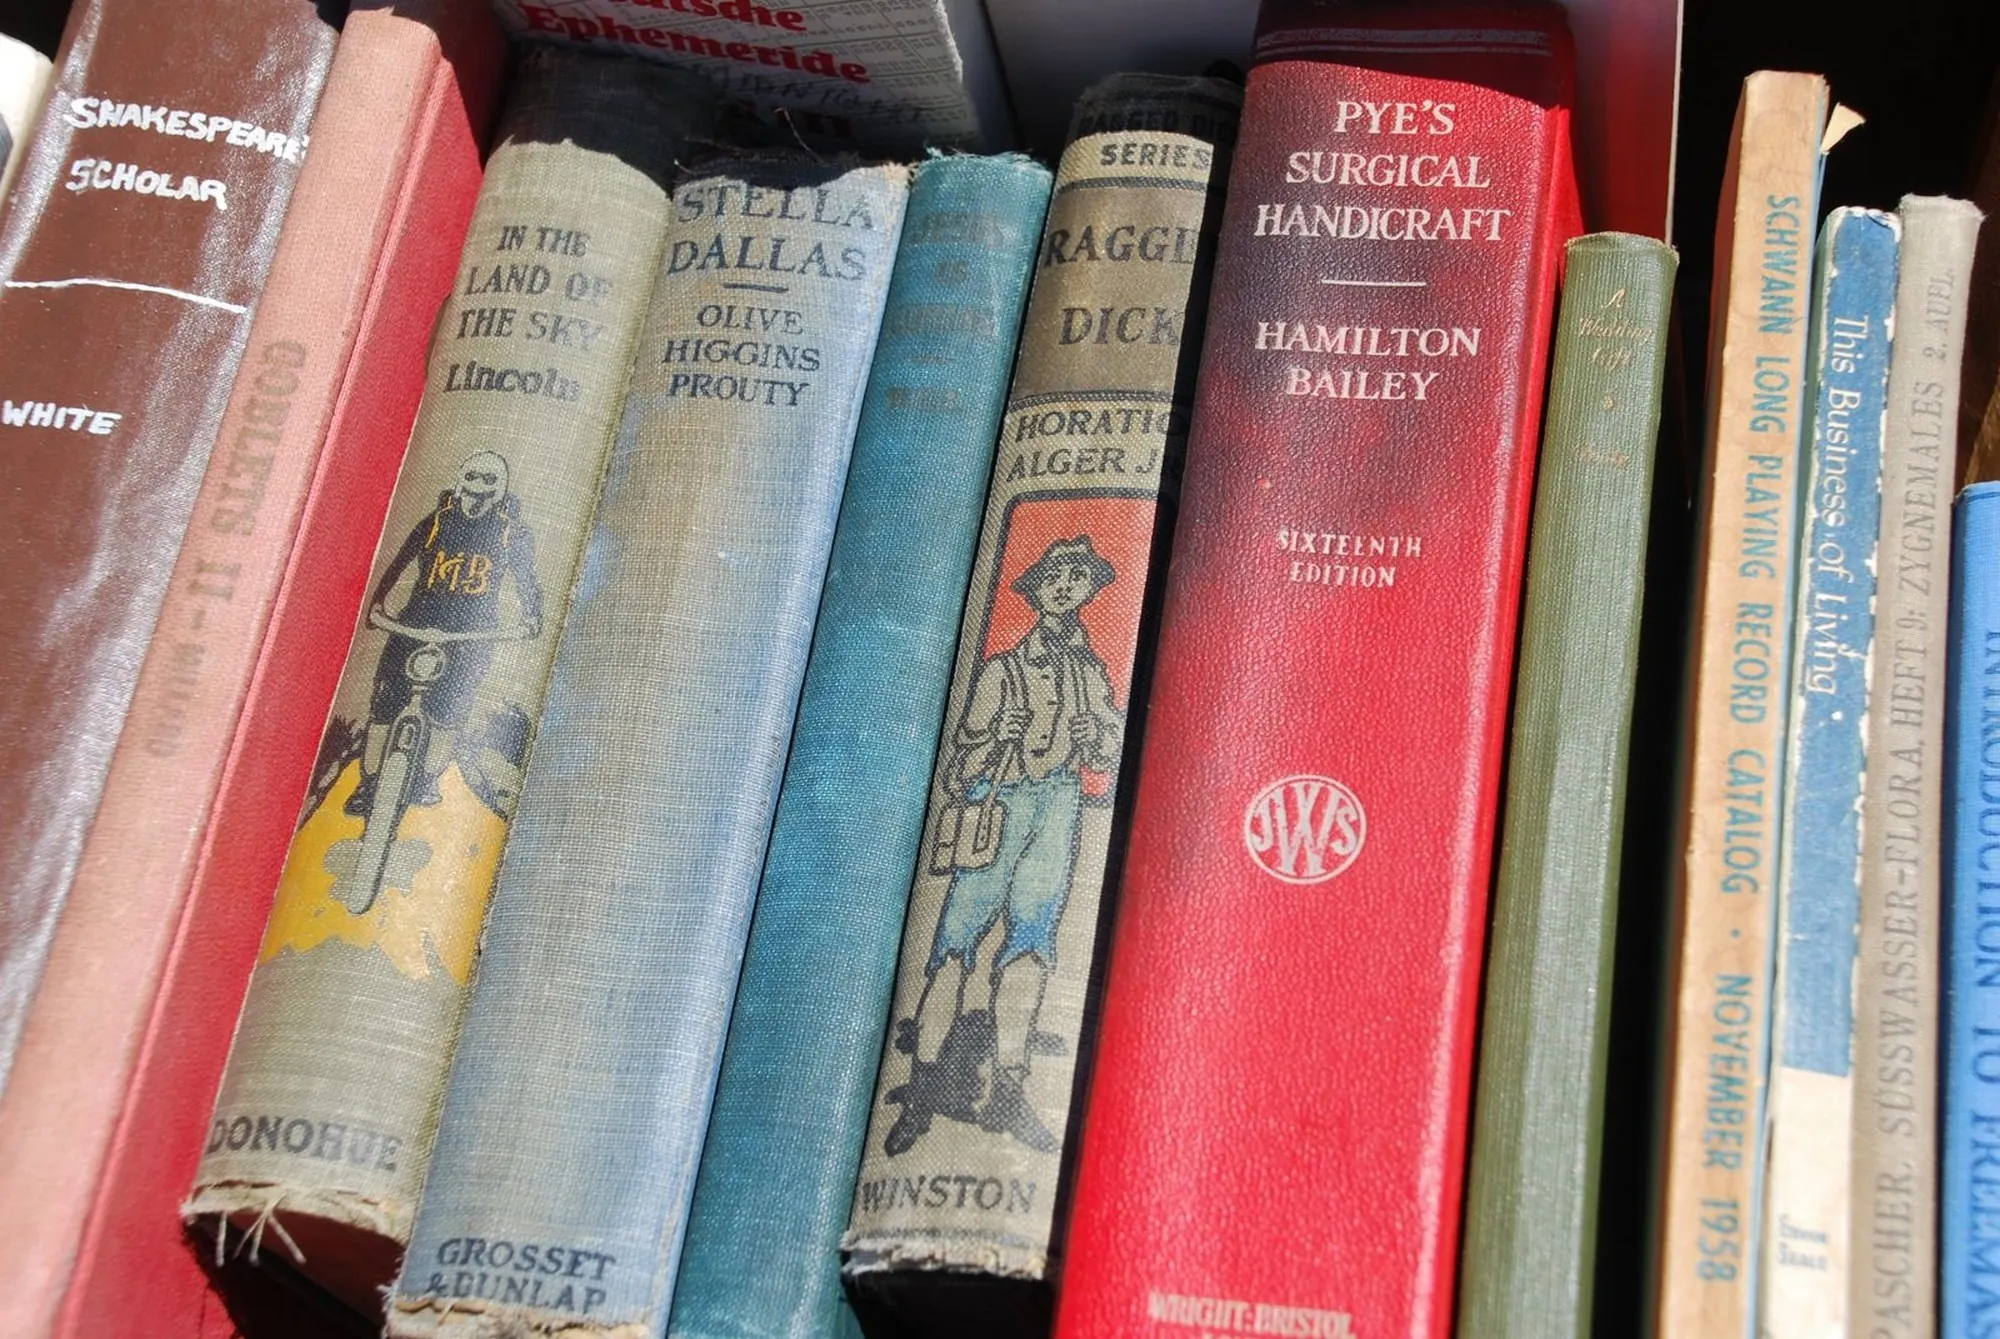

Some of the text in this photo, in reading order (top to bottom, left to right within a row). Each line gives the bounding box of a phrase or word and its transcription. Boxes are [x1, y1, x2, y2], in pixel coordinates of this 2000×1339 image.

[521, 3, 870, 84] Ephemeride
[63, 96, 310, 165] SHAKESPEARE
[1334, 98, 1456, 135] PYE'S
[1099, 142, 1213, 169] SERIES
[1286, 151, 1491, 188] SURGICAL
[65, 158, 228, 211] SCHOLAR
[675, 183, 879, 232] STELLA
[1254, 203, 1513, 241] HANDICRAFT
[496, 225, 589, 257] IN THE
[668, 232, 868, 281] DALLAS
[464, 263, 613, 303] LAND OF
[1928, 266, 1957, 333] AUFL.
[456, 308, 605, 350] THE SKY
[697, 304, 804, 335] OLIVE
[1058, 306, 1186, 346] DICK
[1254, 321, 1482, 357] HAMILTON
[1579, 317, 1652, 346] Wedding
[661, 339, 821, 372] HIGGINS
[1923, 341, 1949, 362] 2.
[443, 360, 580, 400] Lincoln
[666, 373, 810, 408] PROUTY
[1286, 367, 1440, 401] BAILEY
[2, 400, 122, 435] WHITE
[1006, 448, 1125, 482] ALGER
[1806, 314, 1869, 697] This Business of Living
[1897, 379, 1947, 596] ZYGNEMALES
[1278, 530, 1423, 558] SIXTEENTH
[1290, 562, 1397, 588] EDITION
[1895, 609, 1928, 632] 9:
[1889, 639, 1928, 729] HEFT
[1695, 194, 1801, 1283] SCHWANN LONG PLAYING RECORD CATALOG NOVEMBER 1958
[204, 1115, 403, 1173] DONOHUE
[859, 1174, 1038, 1214] WINSTON
[437, 1237, 616, 1281] GROSSET
